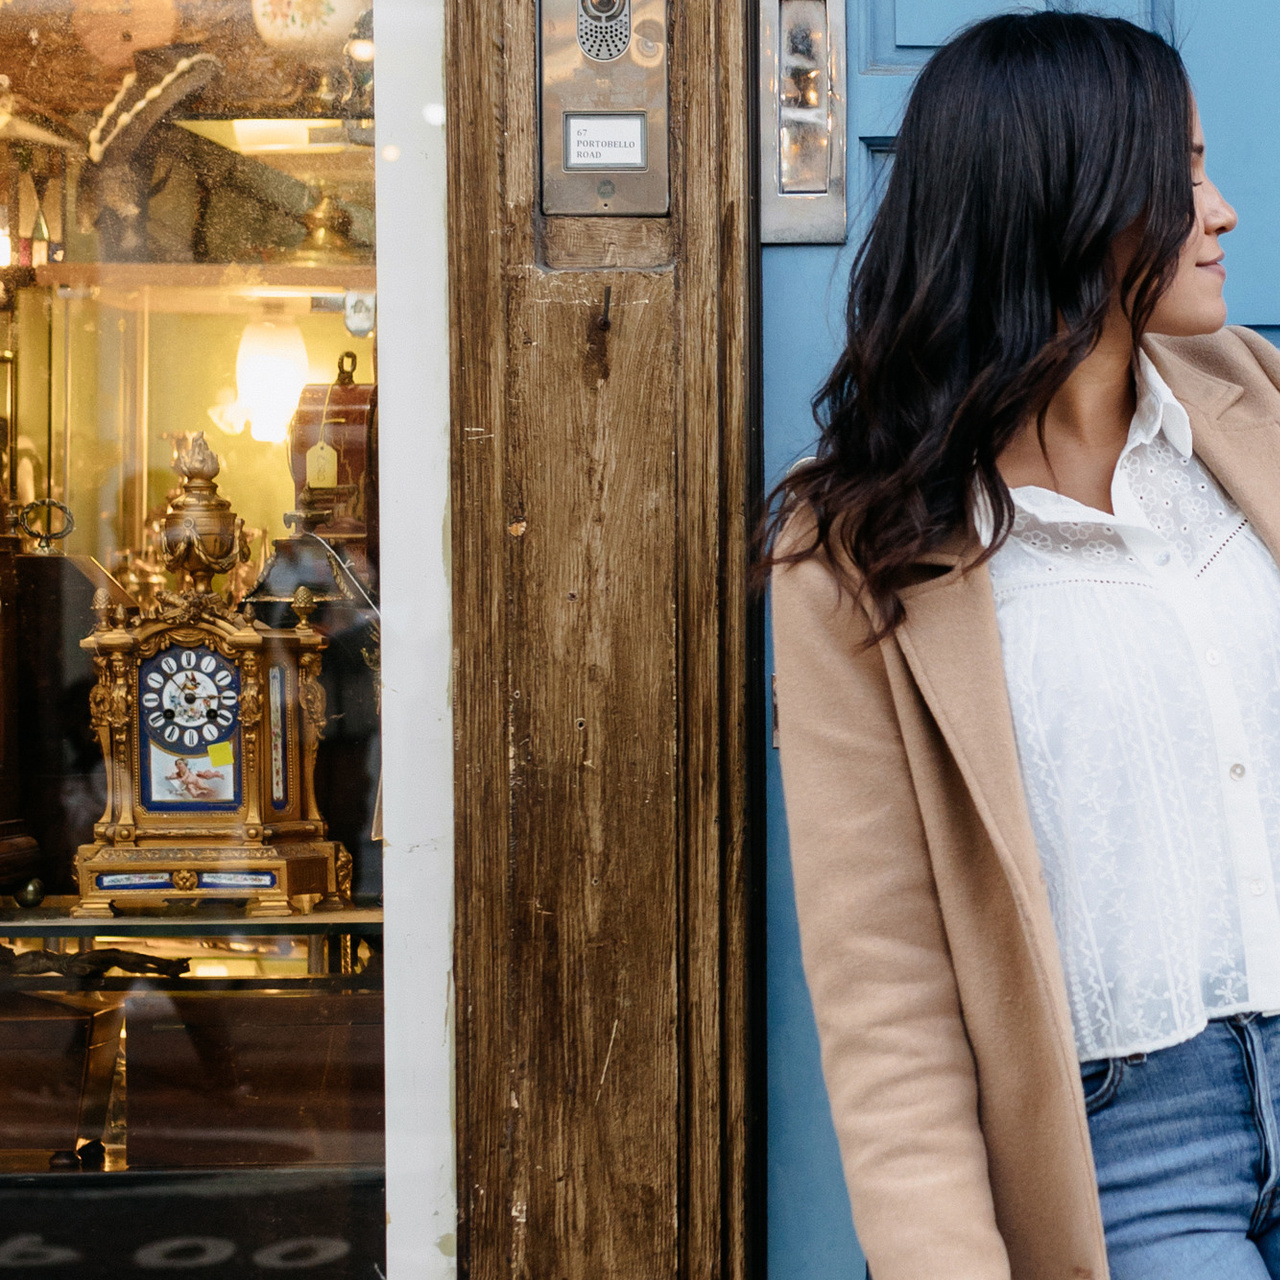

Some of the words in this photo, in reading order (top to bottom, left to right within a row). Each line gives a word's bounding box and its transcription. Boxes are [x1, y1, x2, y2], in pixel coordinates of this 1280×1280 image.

[576, 129, 588, 137] 67
[576, 139, 636, 149] PORTOBELLO
[576, 151, 602, 159] ROAD
